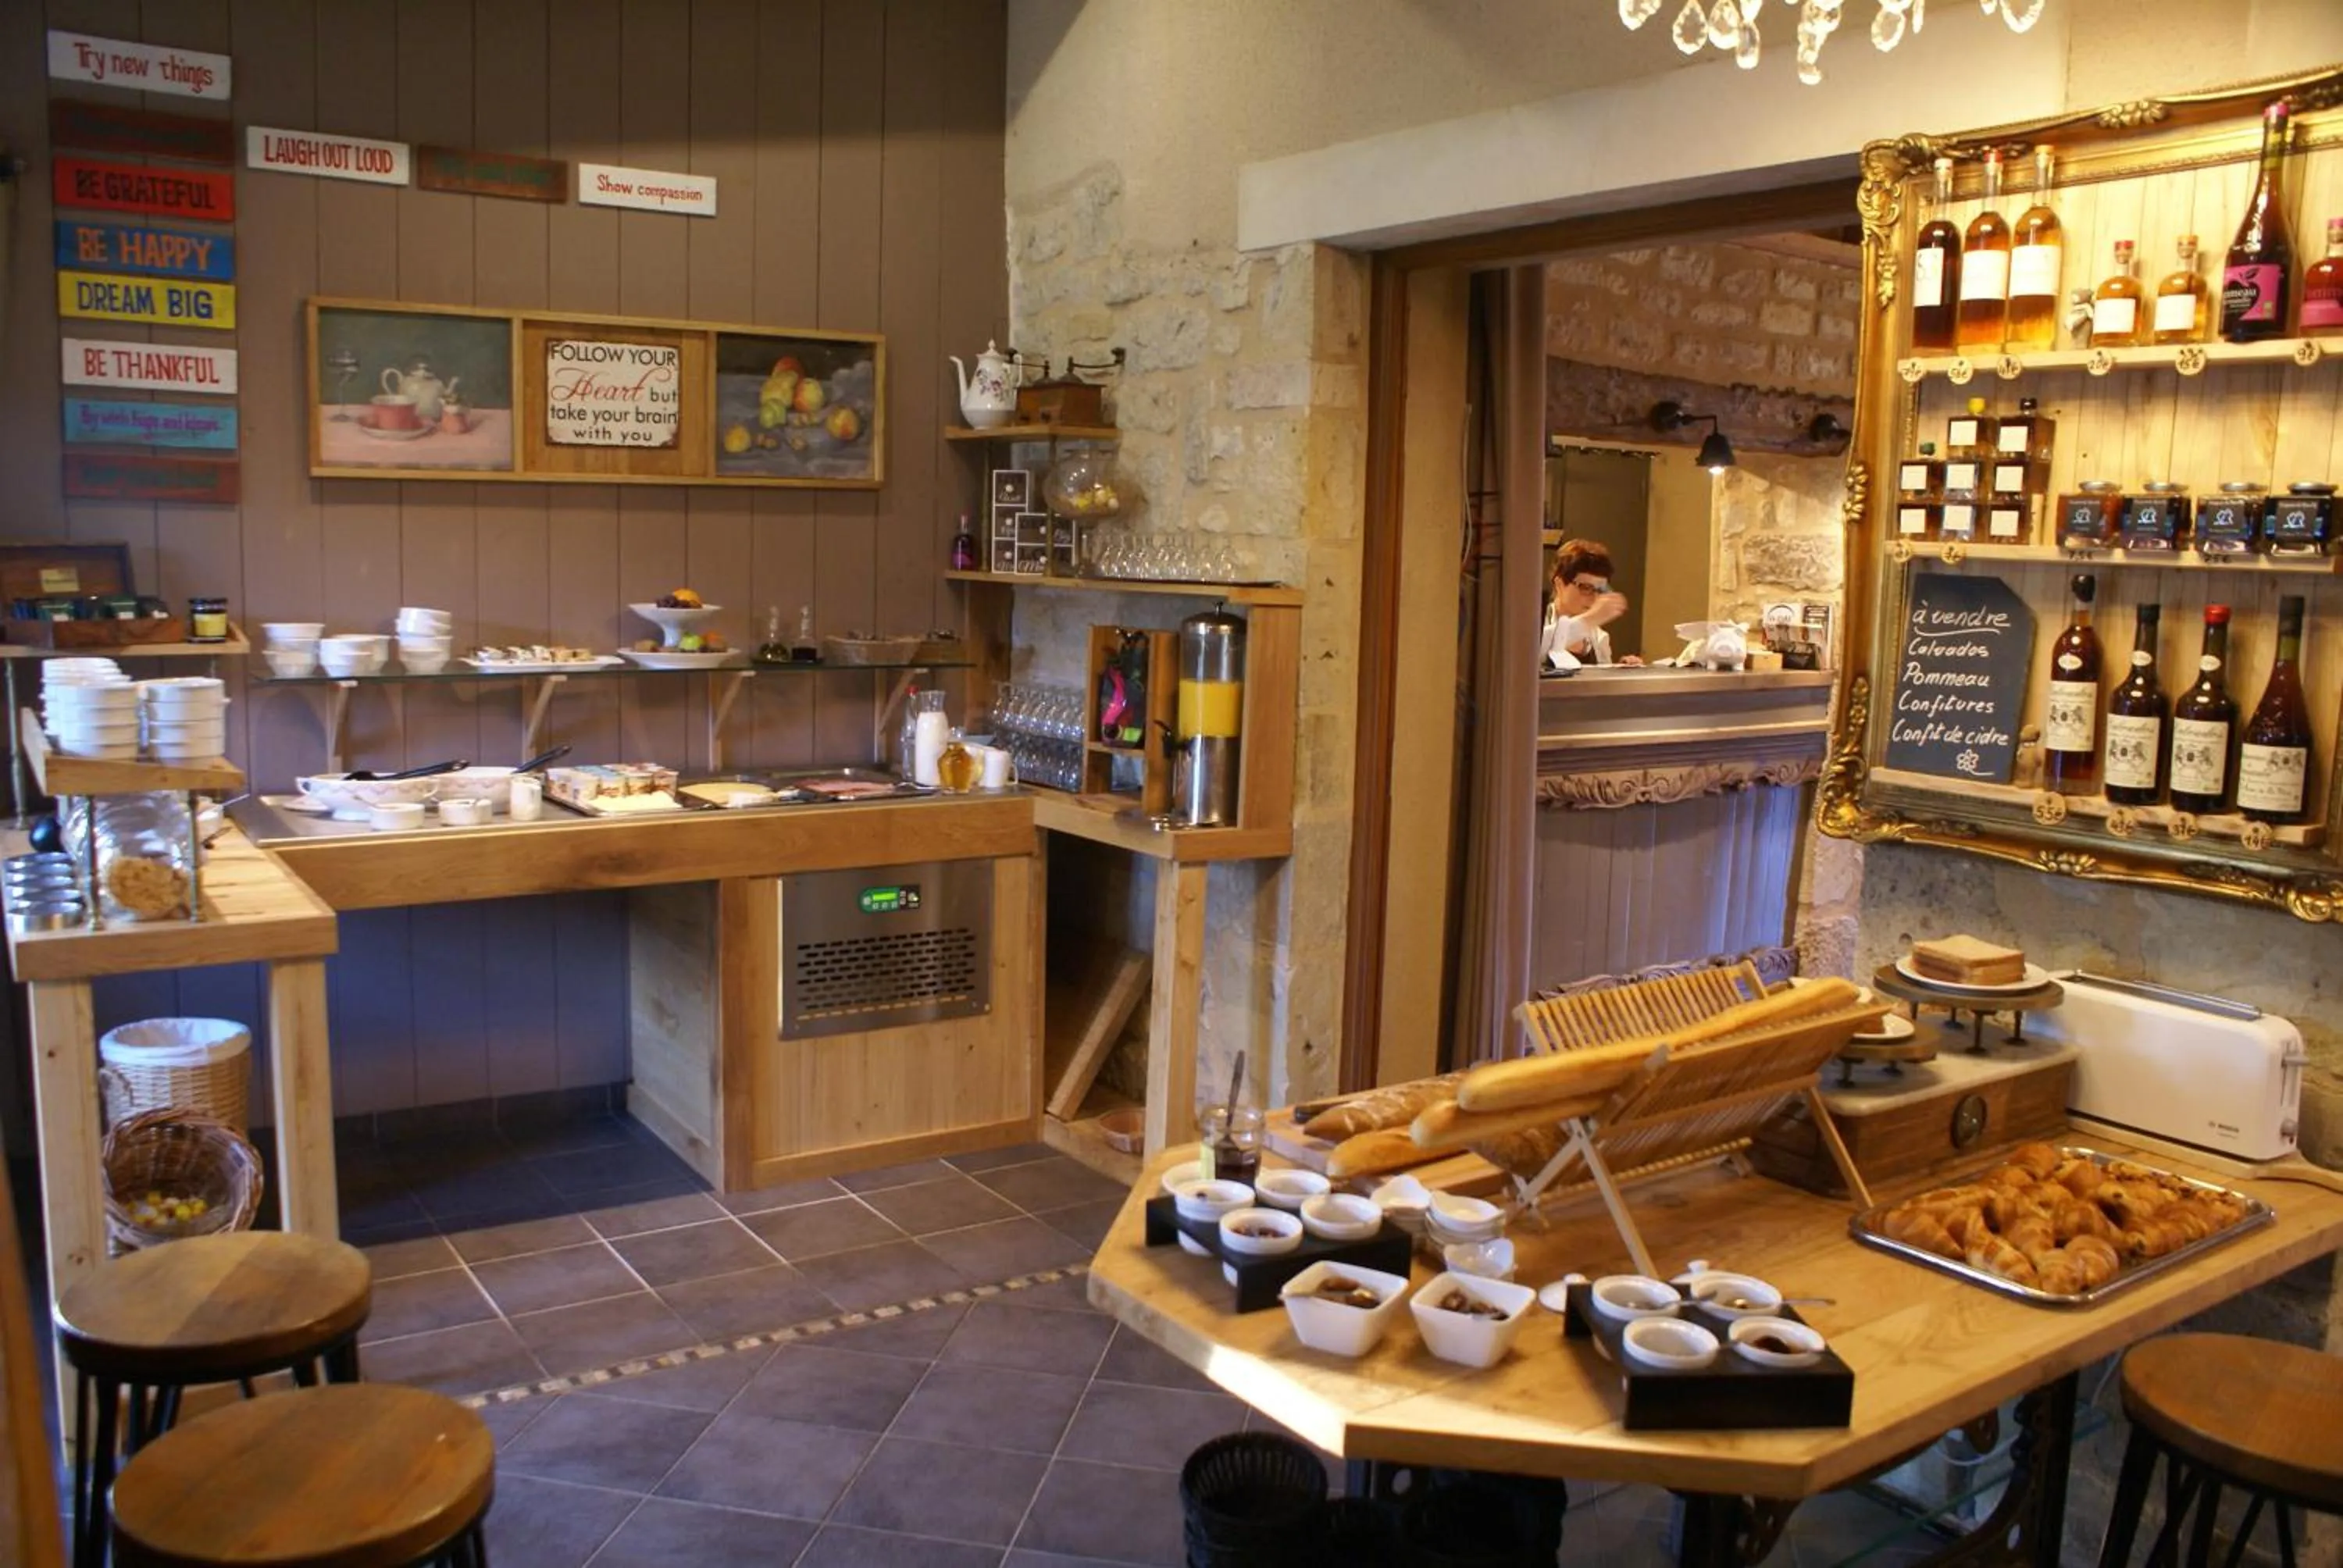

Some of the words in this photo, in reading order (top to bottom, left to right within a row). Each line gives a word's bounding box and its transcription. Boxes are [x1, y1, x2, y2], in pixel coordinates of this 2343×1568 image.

[73, 41, 107, 80] Try
[112, 53, 149, 77] new
[159, 55, 214, 94] things
[263, 134, 320, 167] LAUGH
[323, 142, 351, 169] OUT
[355, 145, 394, 173] LOUD
[75, 169, 102, 196] BE
[105, 169, 215, 210] GRATEFUL
[597, 173, 633, 194] Show
[638, 184, 702, 205] compassion
[76, 226, 109, 262] BE
[119, 230, 212, 270] HAPPY
[76, 280, 157, 315] DREAM
[166, 287, 213, 319] BIG
[84, 347, 109, 377] BE
[112, 351, 220, 384] THANKFUL
[549, 343, 625, 362] FOLLOW
[628, 348, 676, 366] YOUR
[551, 367, 672, 401] Heart
[650, 387, 677, 402] but
[550, 403, 587, 421] take
[592, 408, 630, 426] your
[635, 406, 678, 424] brain
[573, 427, 612, 440] with
[621, 430, 653, 443] you
[1912, 599, 1928, 625] à
[1931, 605, 2011, 627] vendre
[1903, 661, 1990, 687] Pommeau
[1899, 690, 1995, 718] Confitures
[1892, 718, 1945, 747] Confit
[1944, 725, 1963, 743] de
[1965, 725, 2010, 746] cidre
